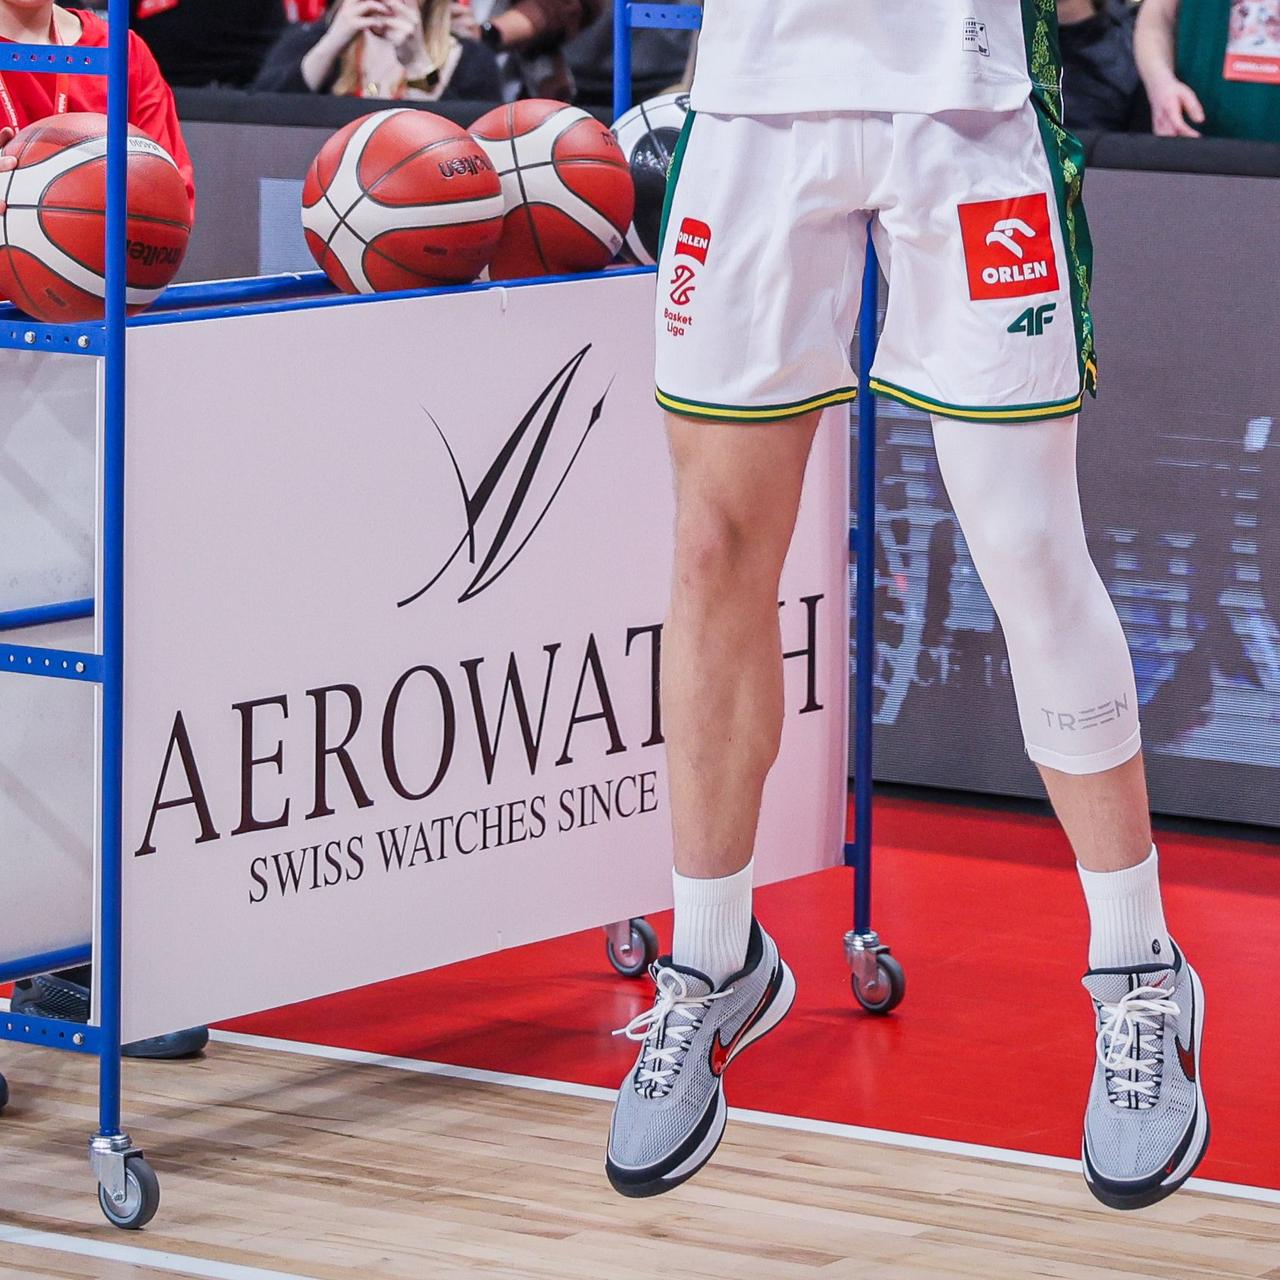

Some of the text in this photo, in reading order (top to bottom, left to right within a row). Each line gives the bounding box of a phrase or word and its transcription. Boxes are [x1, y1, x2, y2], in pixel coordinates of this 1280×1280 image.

[678, 231, 708, 249] ORLEN
[126, 240, 182, 267] molte
[981, 260, 1048, 286] ORLEN
[663, 308, 693, 326] Basket
[666, 321, 685, 337] Liga
[1006, 302, 1057, 337] 4F
[134, 593, 825, 859] AEROWATH
[248, 770, 659, 905] SWISS WATCHES SINCE
